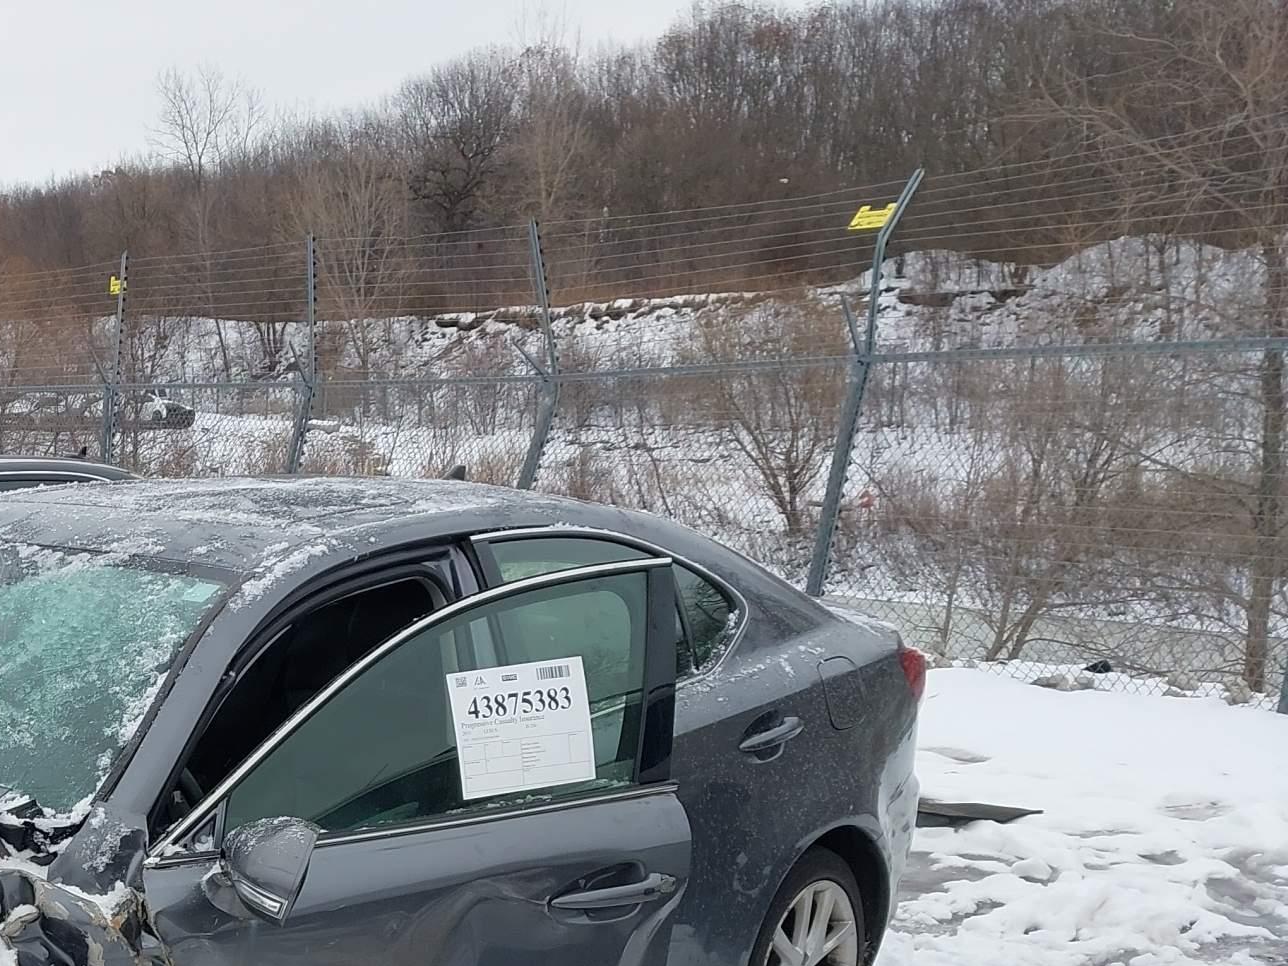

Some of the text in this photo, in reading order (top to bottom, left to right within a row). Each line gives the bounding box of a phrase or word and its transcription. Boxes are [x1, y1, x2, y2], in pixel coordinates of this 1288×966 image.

[468, 686, 572, 719] 43875383
[461, 720, 494, 730] Progressive
[494, 717, 518, 726] Casualty
